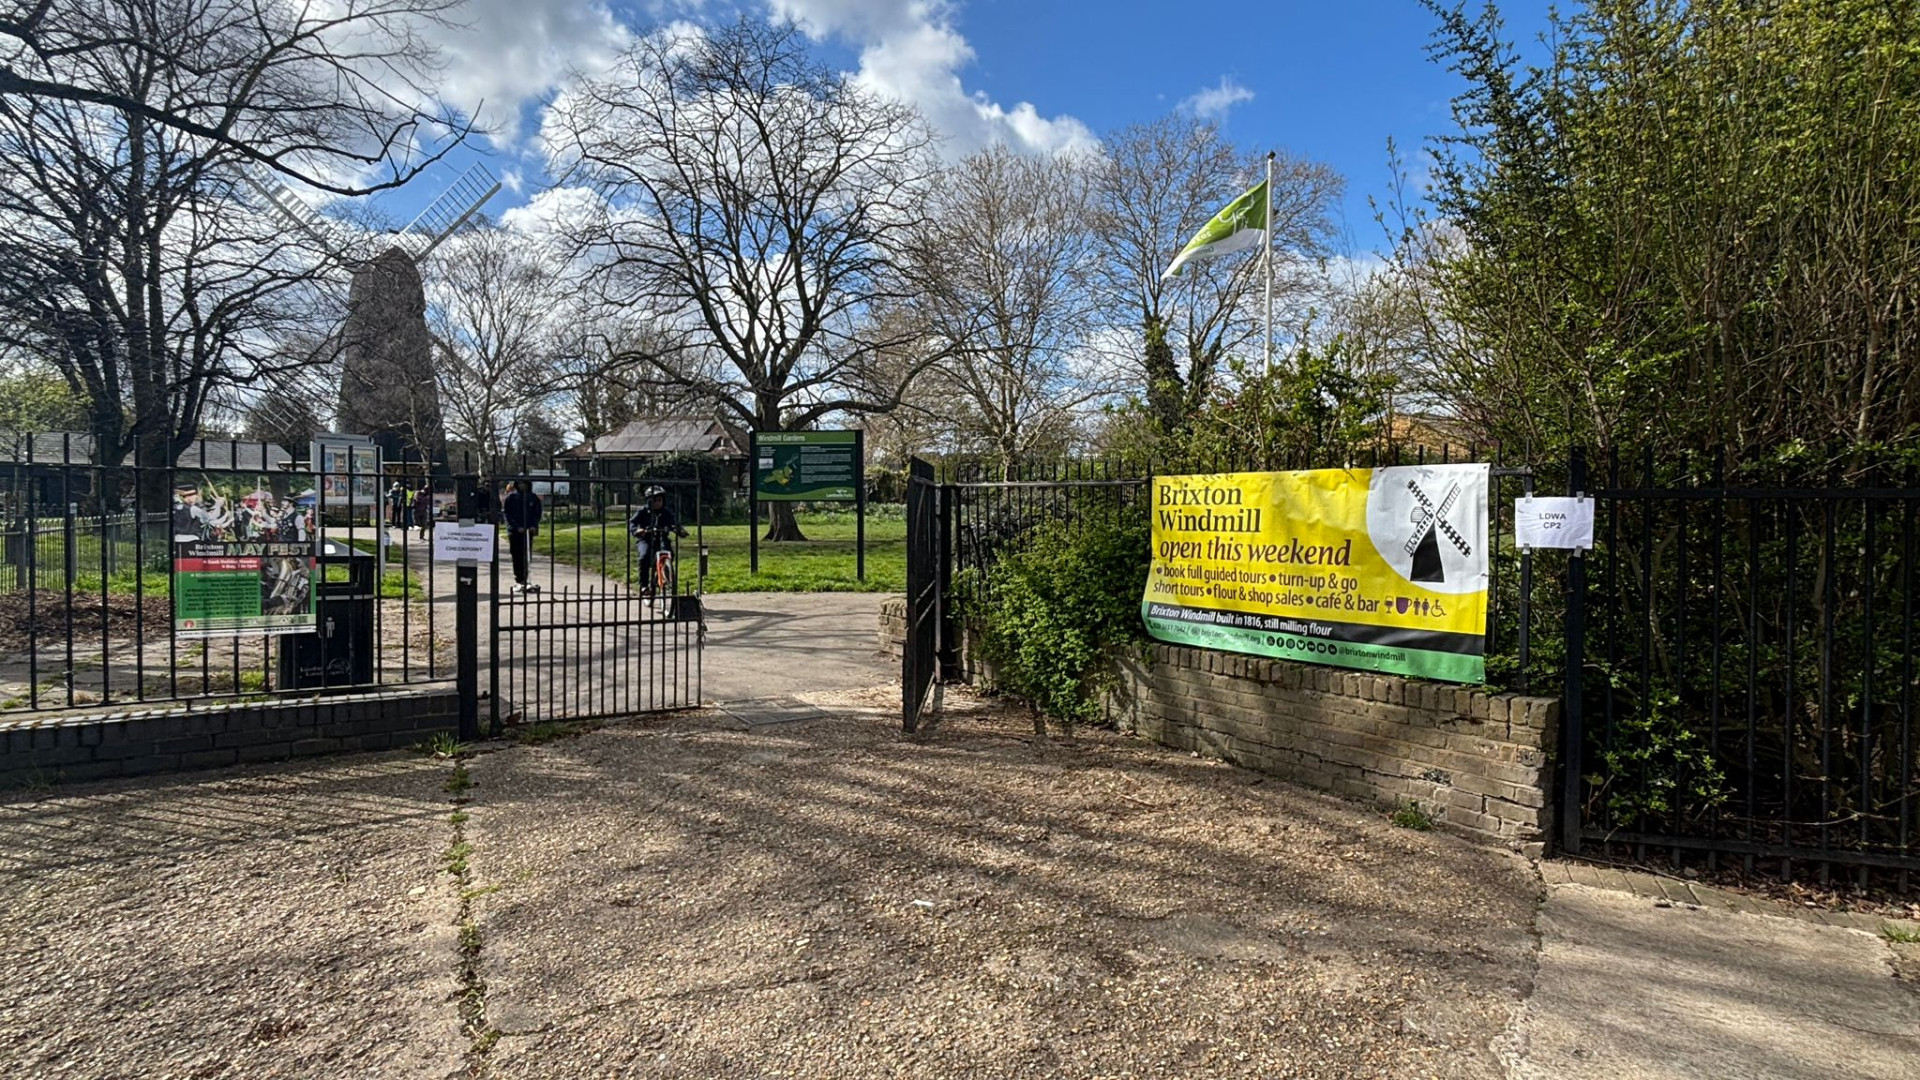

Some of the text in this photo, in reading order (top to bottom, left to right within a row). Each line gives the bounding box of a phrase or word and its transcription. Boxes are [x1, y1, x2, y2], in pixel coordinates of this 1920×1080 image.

[758, 434, 782, 442] Windmill
[1159, 483, 1243, 506] Brixton
[1158, 508, 1261, 533] Windmill
[226, 543, 311, 556] MAY FEST
[1160, 536, 1352, 566] open this weekend
[1163, 563, 1358, 594] book full guided tours turn-up & go
[1153, 580, 1380, 612] short tours flour & shop sales café & bar
[1150, 604, 1333, 636] Brixton Windmill built in 1816, still milling flour
[1339, 646, 1406, 662] @brixtonwindmill
